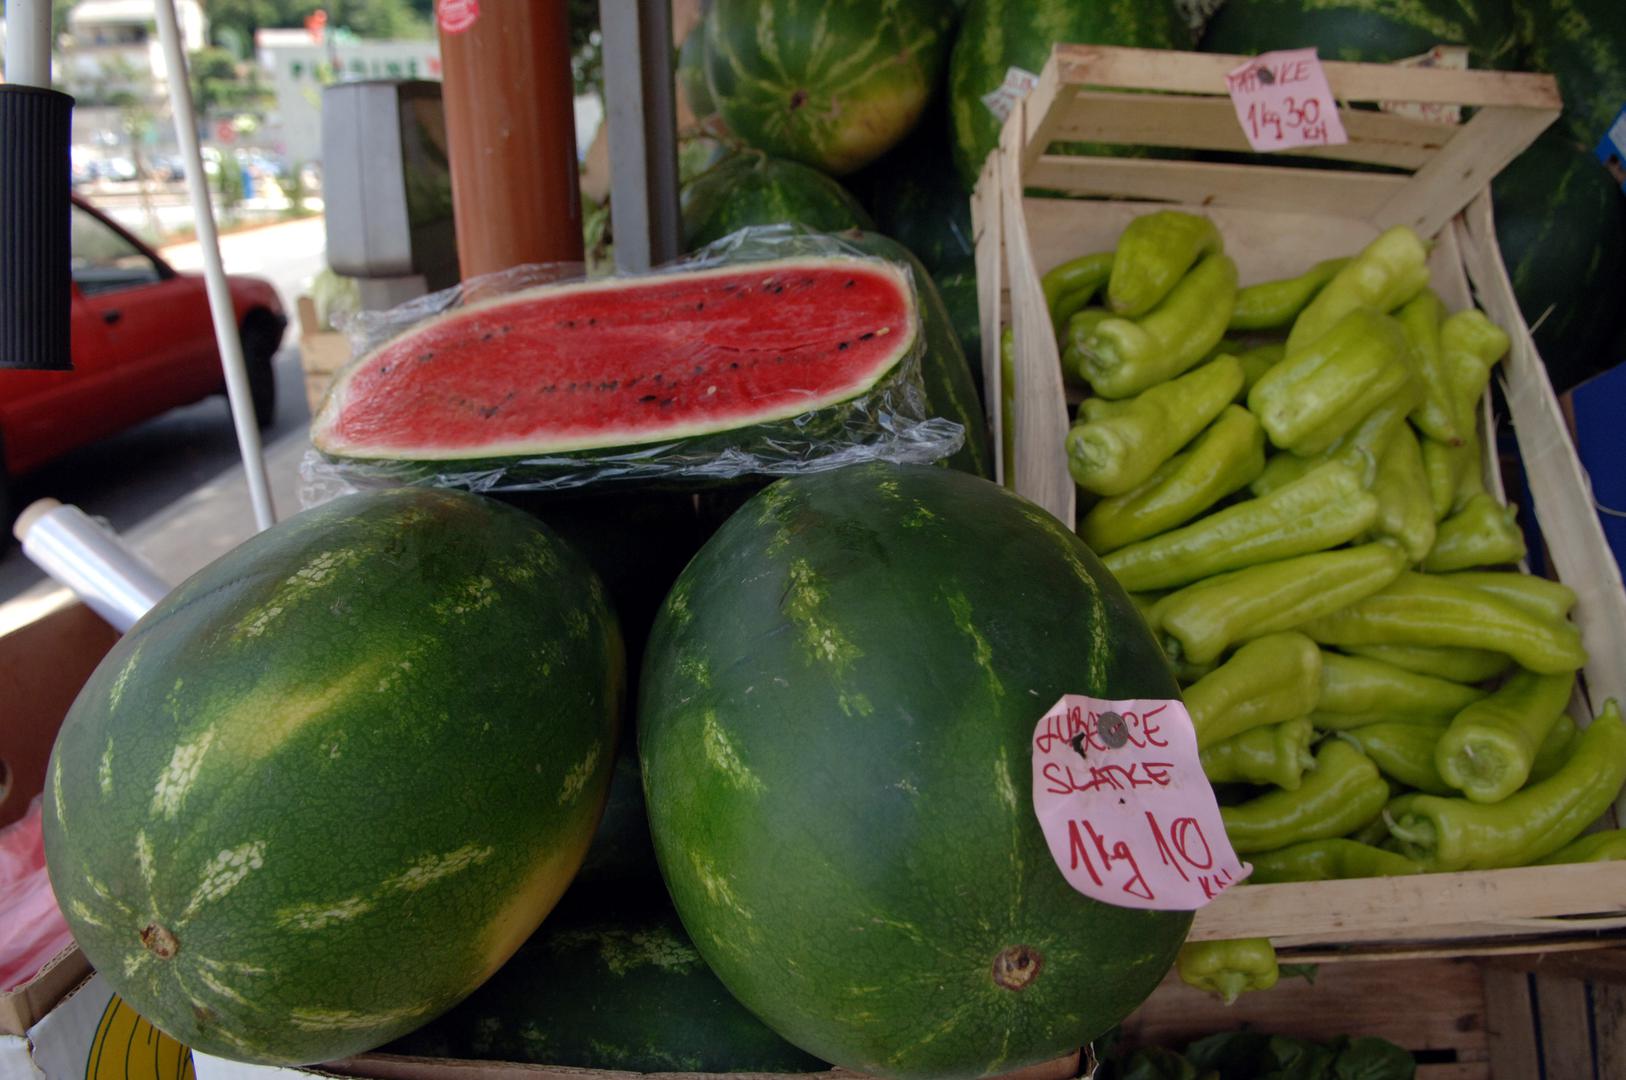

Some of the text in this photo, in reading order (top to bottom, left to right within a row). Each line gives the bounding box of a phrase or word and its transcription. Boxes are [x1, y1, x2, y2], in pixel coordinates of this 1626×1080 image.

[1283, 96, 1319, 128] 30
[1042, 762, 1174, 795] SLATKE
[1145, 811, 1213, 882] 10
